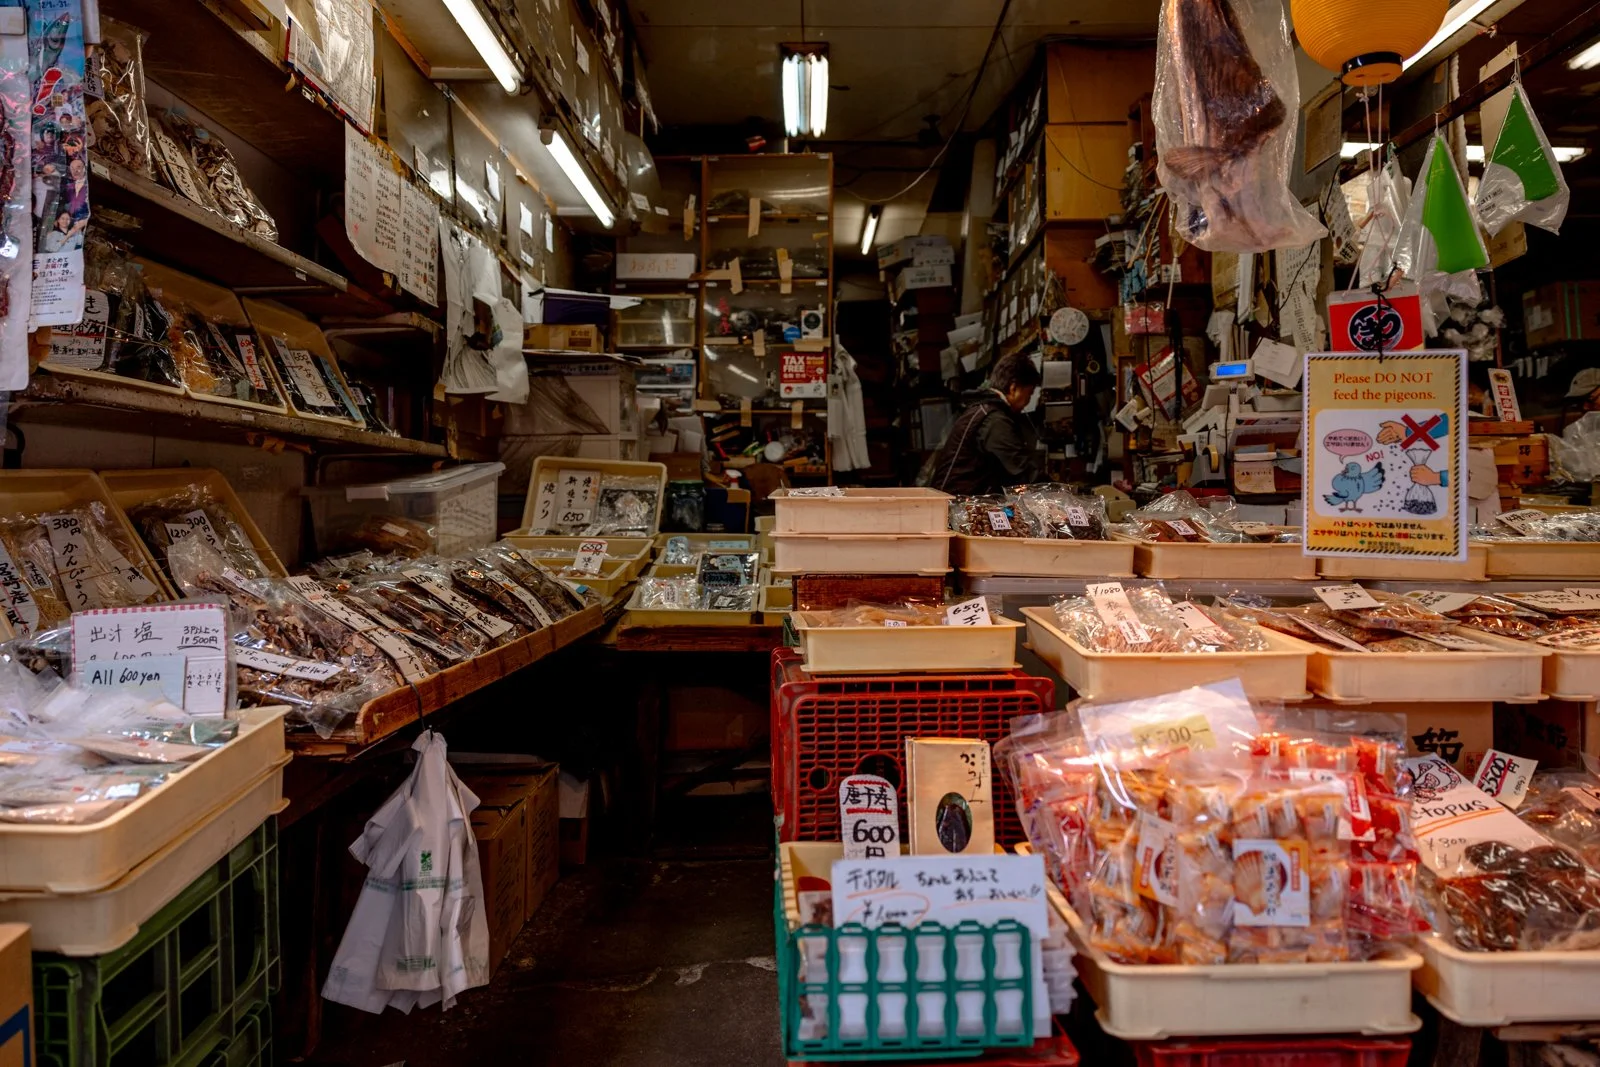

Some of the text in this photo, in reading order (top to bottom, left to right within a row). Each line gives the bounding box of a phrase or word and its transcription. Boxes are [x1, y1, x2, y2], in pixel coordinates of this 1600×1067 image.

[784, 356, 805, 365] TAX
[784, 364, 806, 373] FREE
[1334, 372, 1433, 384] Please DO NOT
[1334, 389, 1436, 402] feed the pigeons.
[1366, 450, 1384, 462] NO!
[562, 512, 584, 522] 650
[52, 518, 78, 530] 380
[581, 543, 602, 551] 650
[62, 542, 88, 606] かんぴょう
[952, 603, 980, 614] 650
[91, 624, 122, 643] 出汁
[92, 667, 160, 686] All 600 yen
[1410, 800, 1490, 819] ctopus
[852, 818, 896, 844] 600
[865, 846, 886, 858] 円
